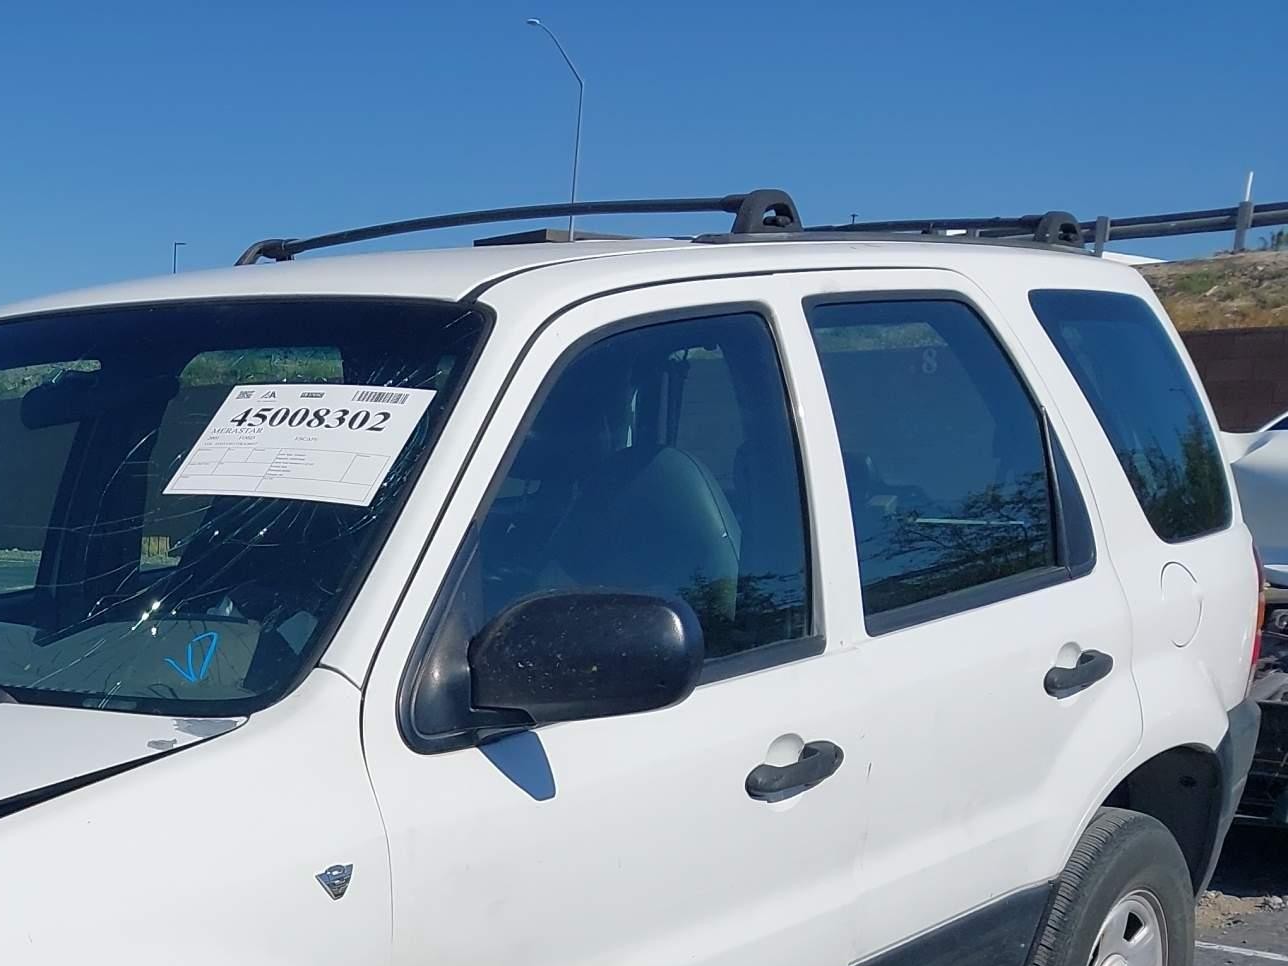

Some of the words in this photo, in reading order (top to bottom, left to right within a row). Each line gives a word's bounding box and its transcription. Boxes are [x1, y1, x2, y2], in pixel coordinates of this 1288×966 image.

[922, 348, 937, 374] 8
[212, 427, 264, 435] MERASTAR
[230, 406, 391, 432] 45008302
